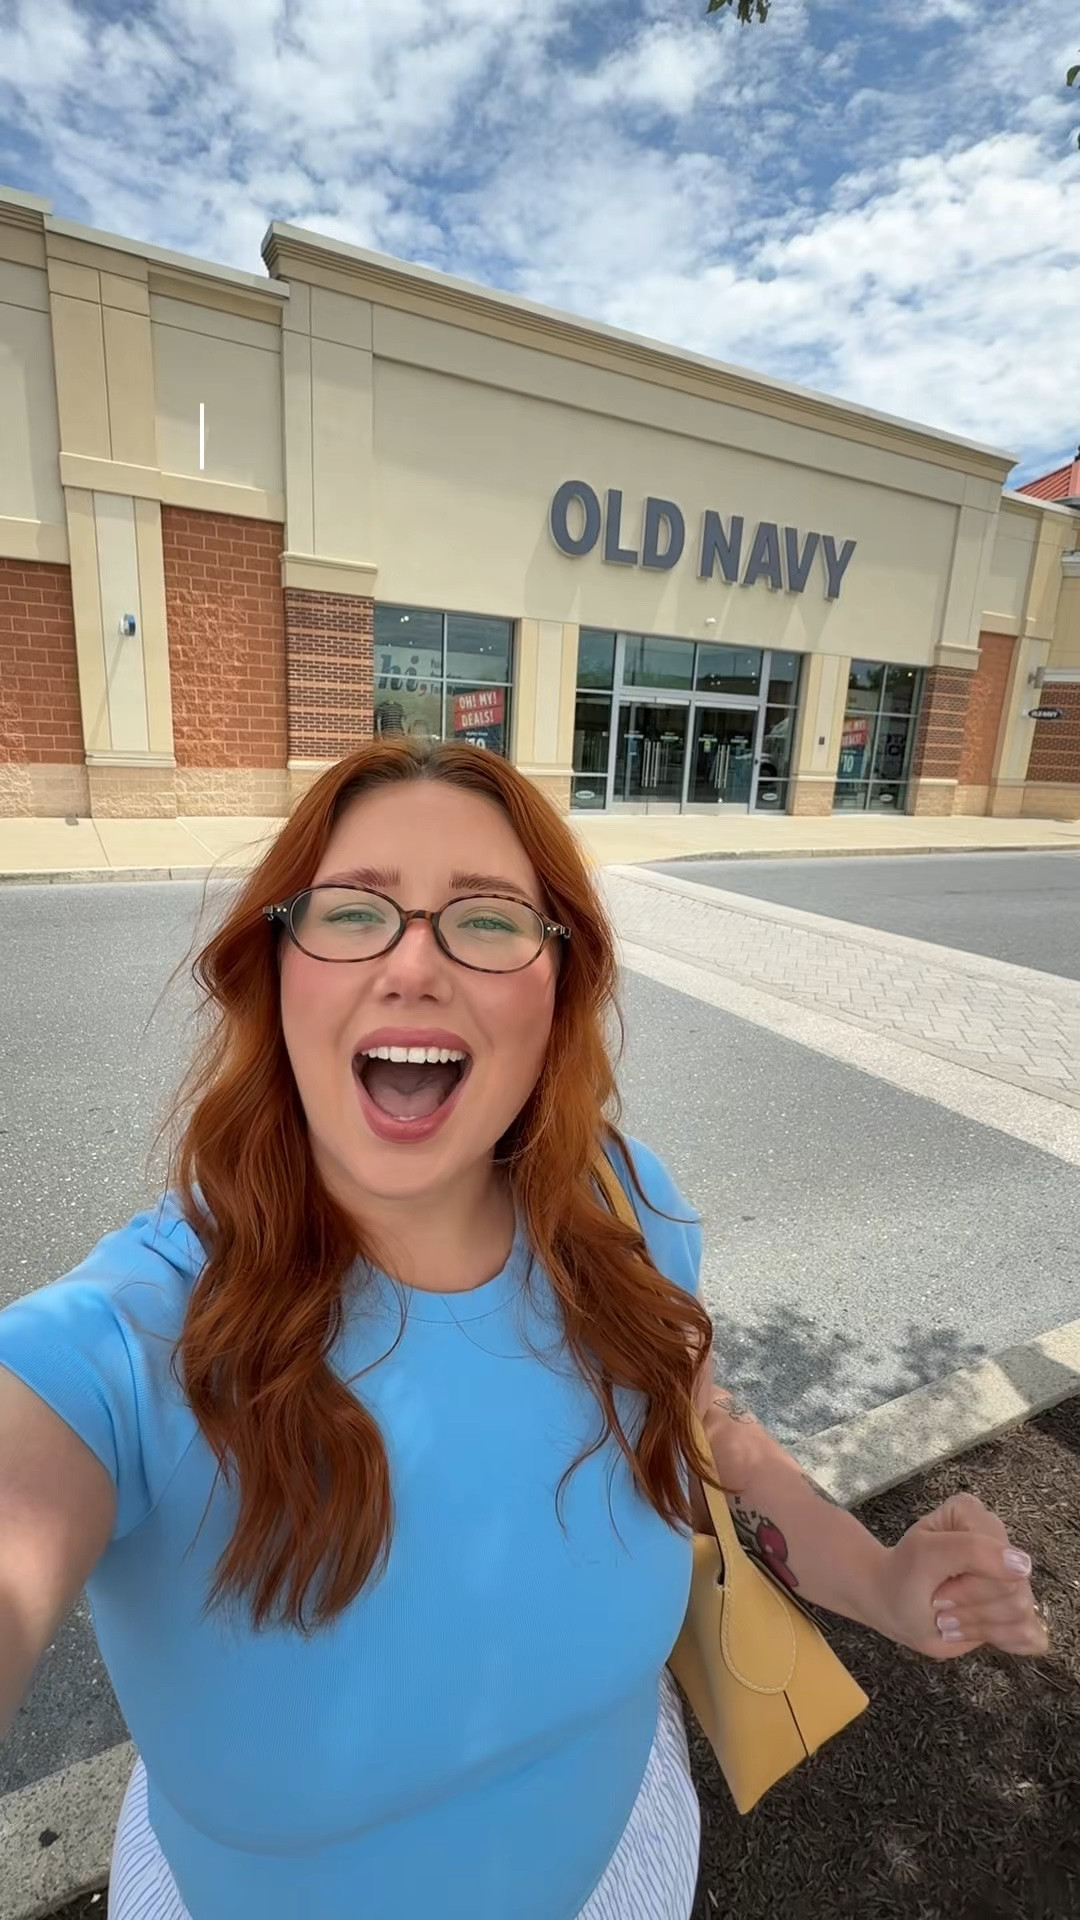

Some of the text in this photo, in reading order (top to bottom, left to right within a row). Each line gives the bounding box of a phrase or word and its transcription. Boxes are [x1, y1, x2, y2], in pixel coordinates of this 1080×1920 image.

[549, 479, 857, 602] OLD NAVY
[459, 690, 497, 709] OH! MY!
[461, 709, 495, 727] DEALS!
